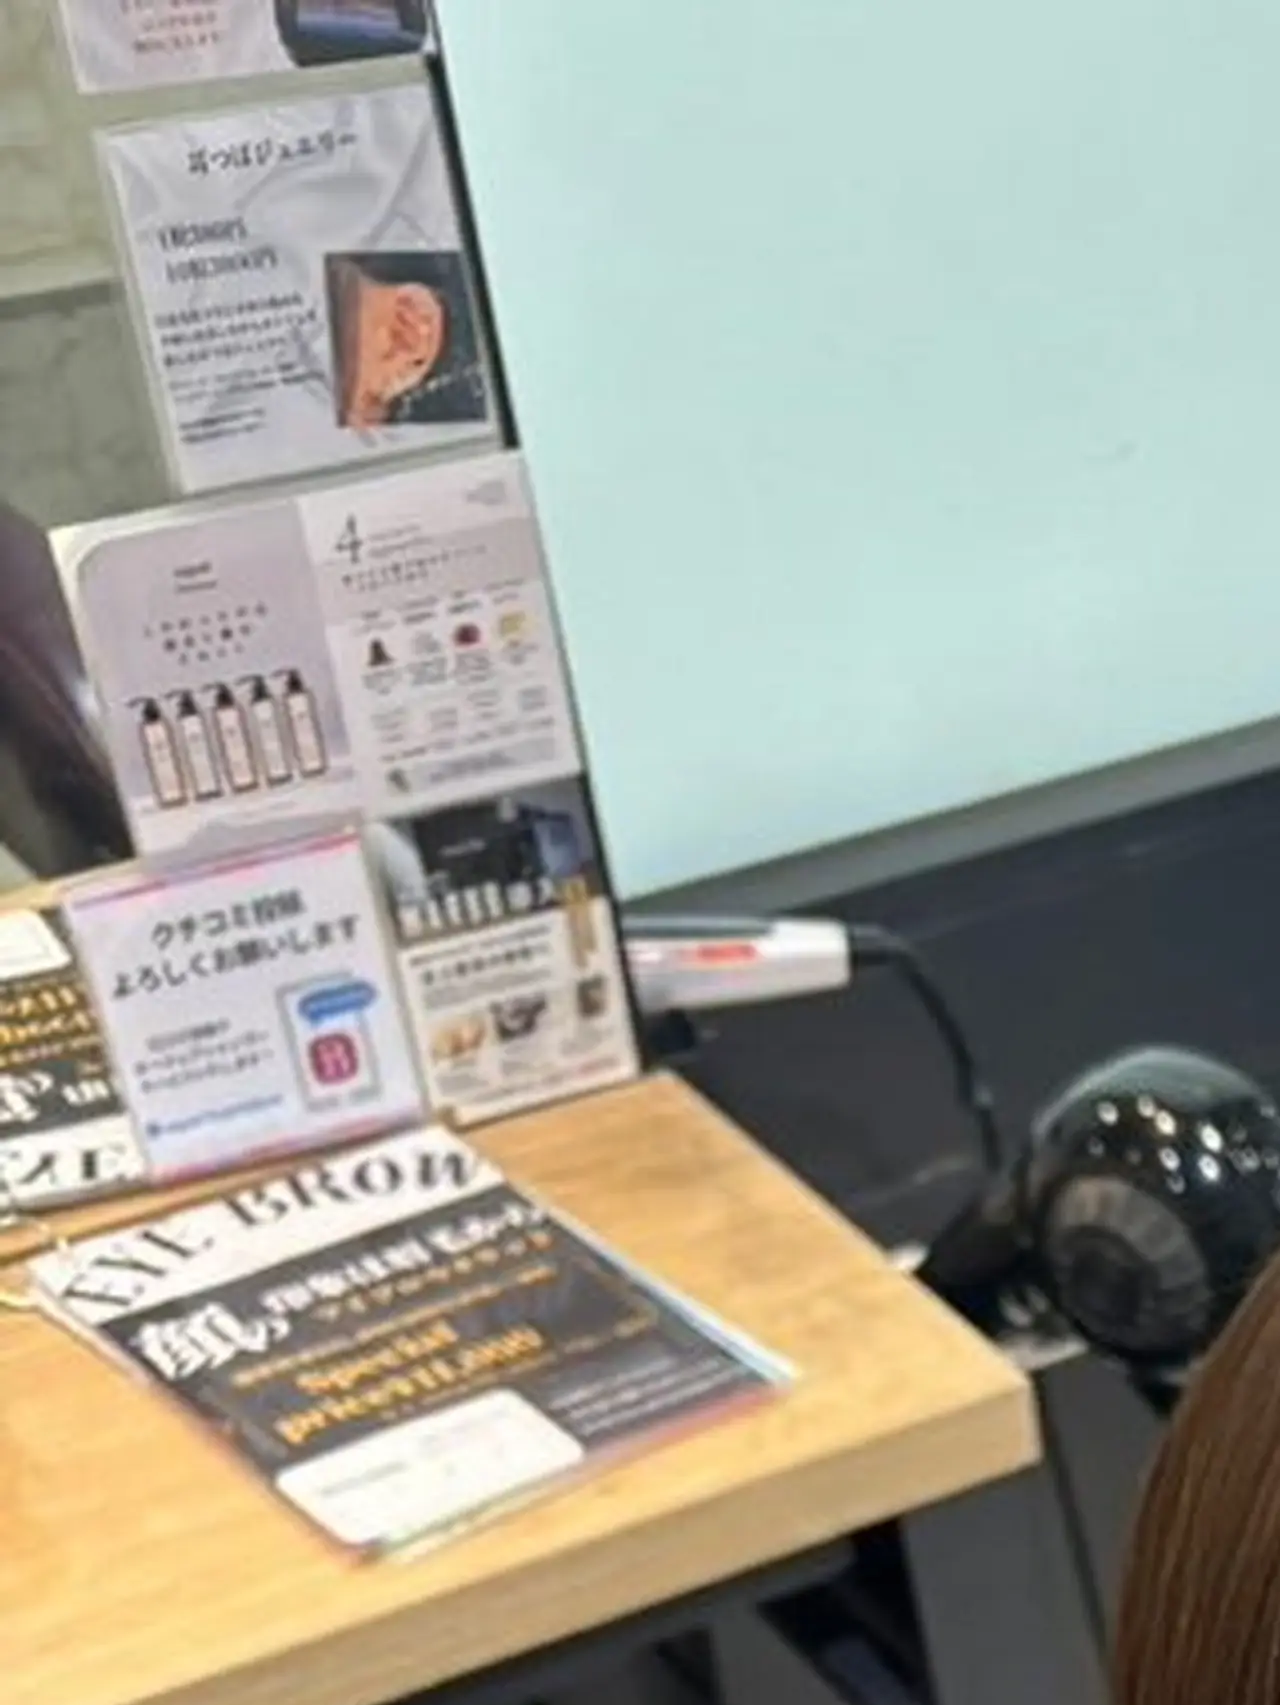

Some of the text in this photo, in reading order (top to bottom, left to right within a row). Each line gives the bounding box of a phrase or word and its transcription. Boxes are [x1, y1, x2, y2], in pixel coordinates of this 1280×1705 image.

[112, 914, 360, 998] よろしくお願いします
[64, 1224, 214, 1307] EYE
